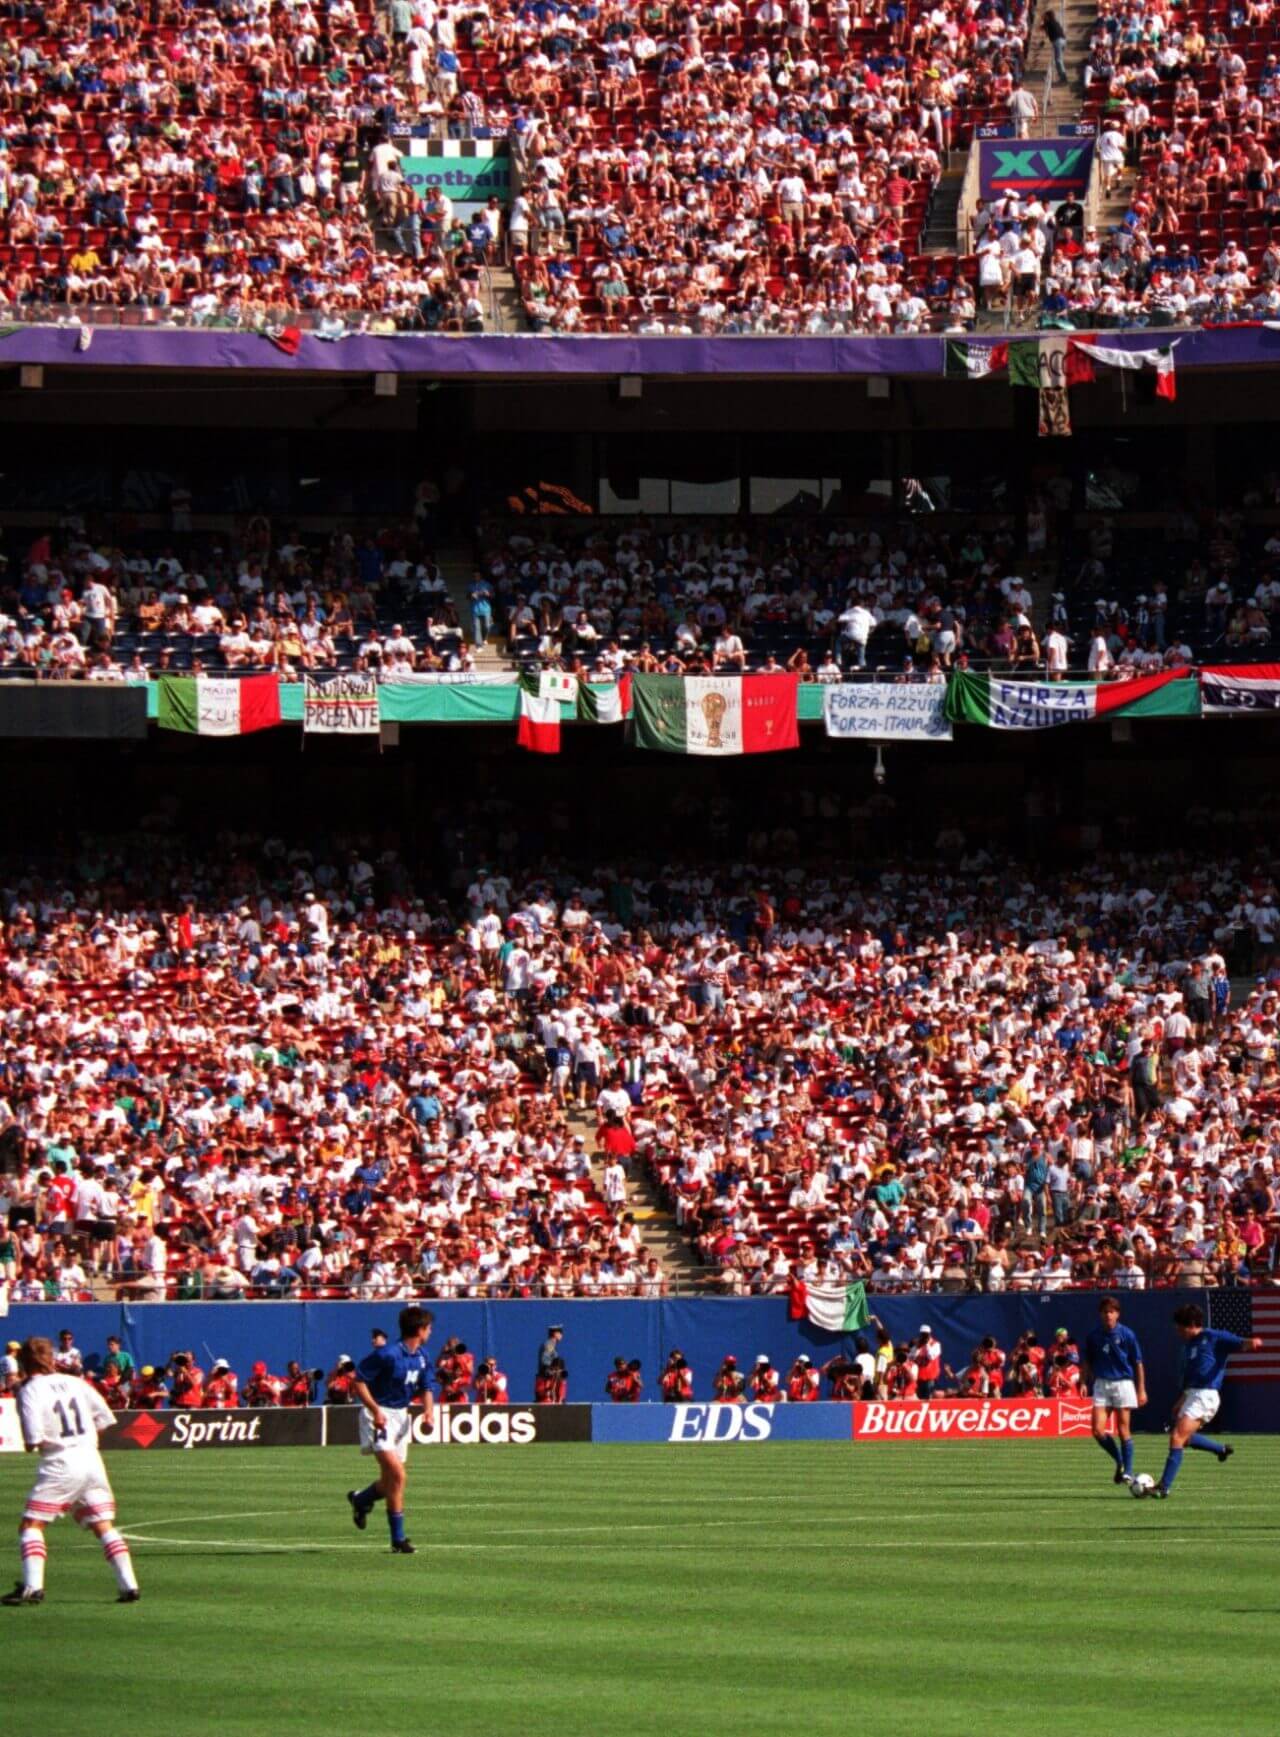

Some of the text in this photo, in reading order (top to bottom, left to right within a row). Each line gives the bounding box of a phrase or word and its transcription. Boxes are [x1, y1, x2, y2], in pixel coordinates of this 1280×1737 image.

[393, 126, 411, 135] 323
[489, 127, 508, 136] 324
[980, 127, 998, 136] 324
[1075, 125, 1095, 134] 325
[992, 149, 1083, 177] XV
[405, 169, 511, 186] ootball
[1001, 684, 1087, 706] FORZA
[994, 705, 1089, 727] AZZURRI
[1102, 1342, 1110, 1354] 4
[53, 1397, 87, 1438] 11
[407, 1404, 537, 1444] didas
[668, 1404, 775, 1441] EDS
[859, 1402, 1050, 1434] Budweiser
[171, 1414, 261, 1449] Sprint
